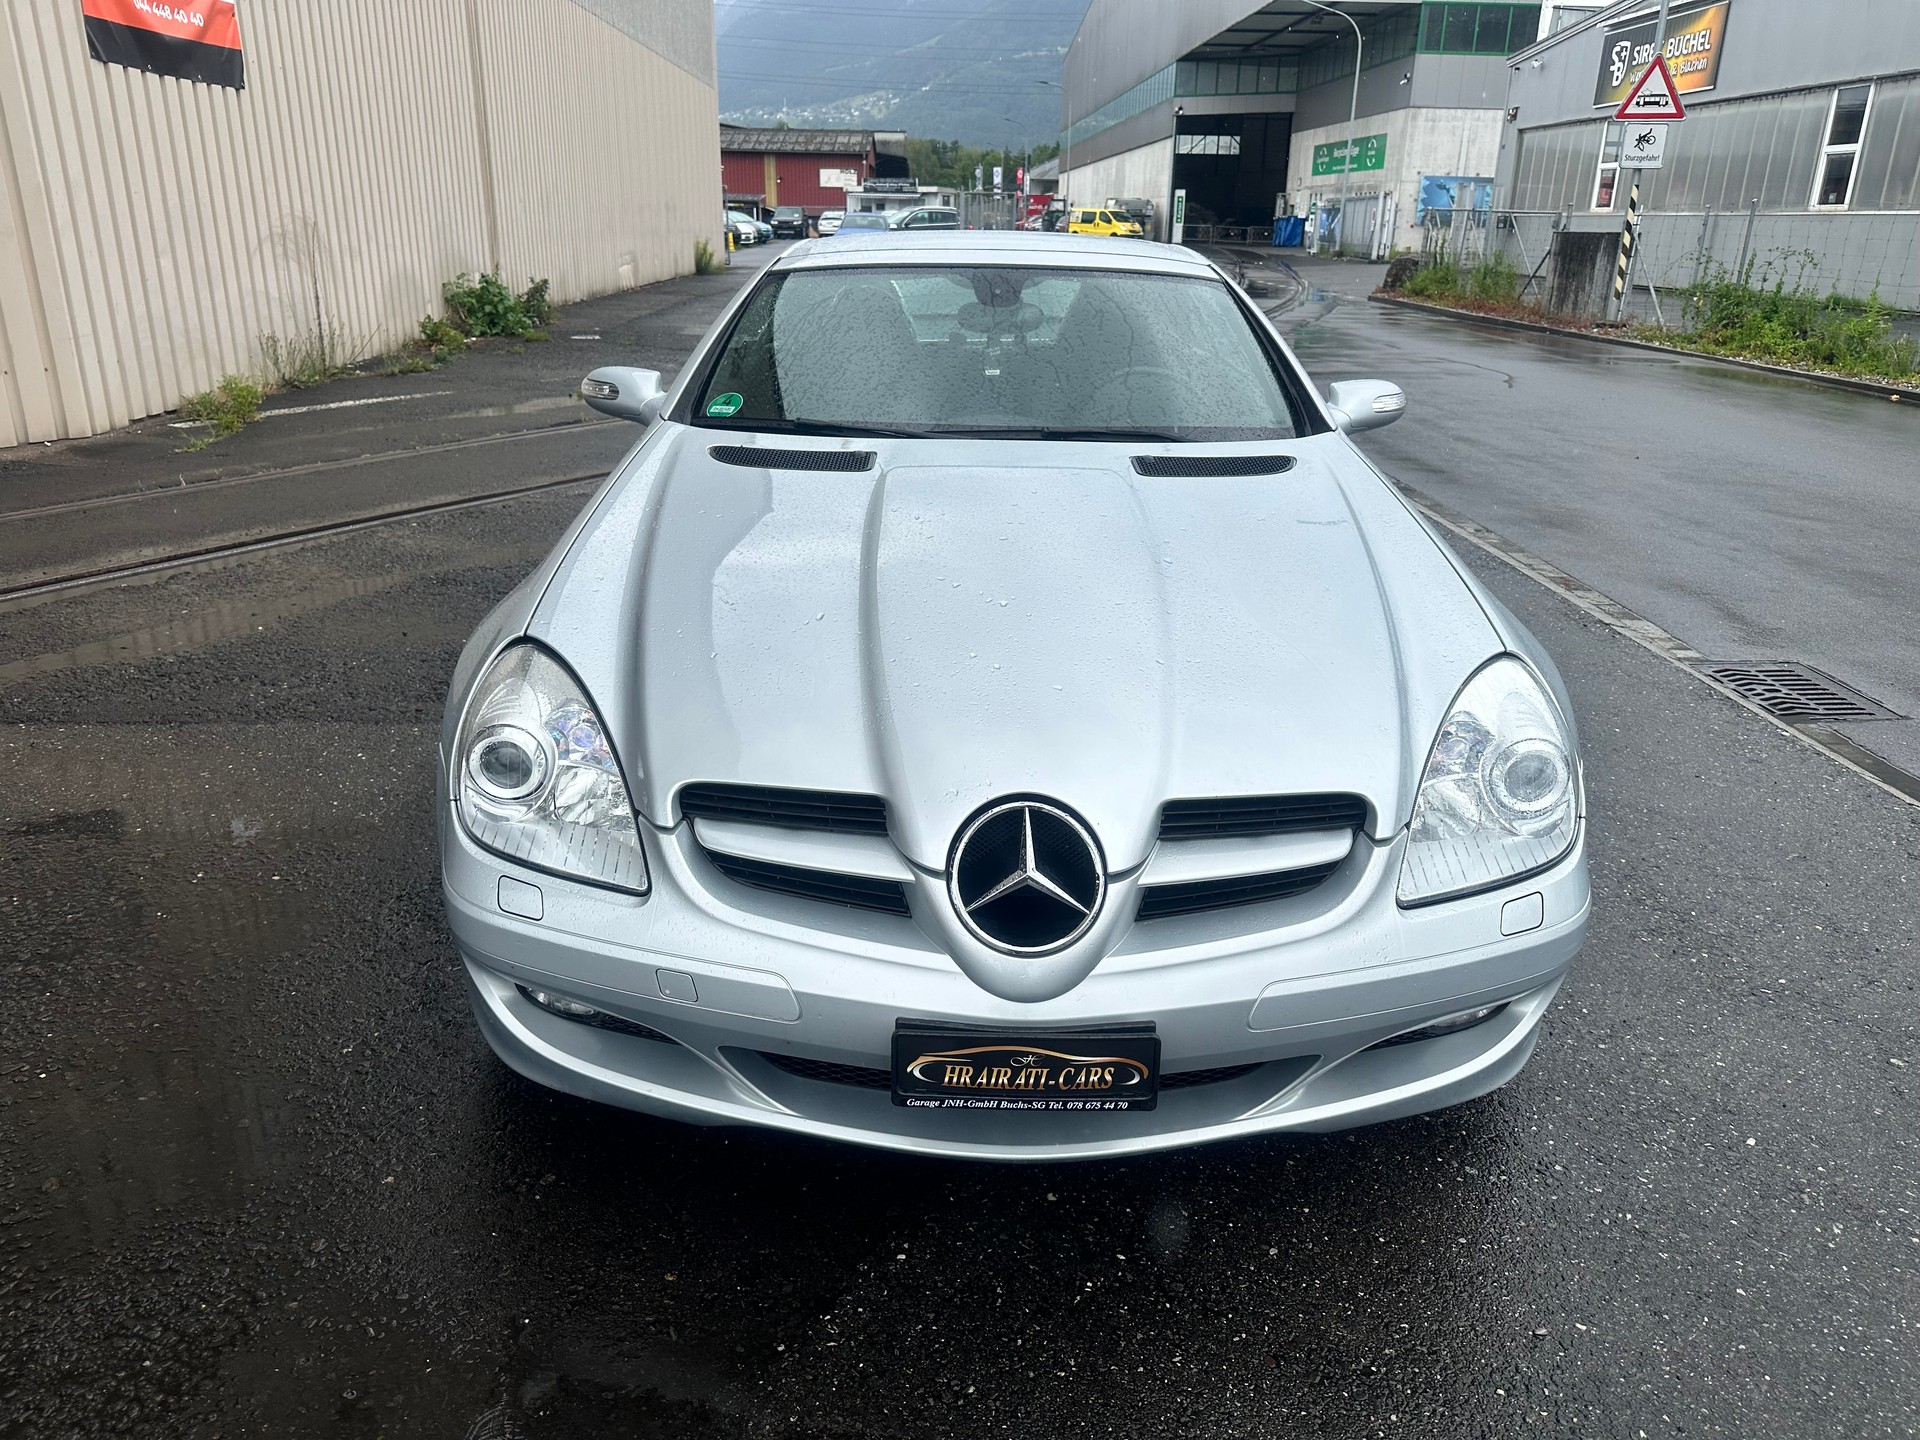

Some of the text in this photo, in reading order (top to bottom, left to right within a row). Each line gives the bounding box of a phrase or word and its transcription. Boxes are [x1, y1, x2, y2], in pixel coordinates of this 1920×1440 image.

[152, 2, 172, 20] 448
[174, 8, 188, 24] 40
[190, 11, 204, 27] 40
[1632, 40, 1665, 66] SIRE
[1624, 154, 1661, 163] Sturzgefahr!
[941, 1064, 1115, 1091] HRAIRATI-CARS
[906, 1098, 1129, 1110] Garage JNH-GmbH Buchs-SG Tel. 078 675 44 70
